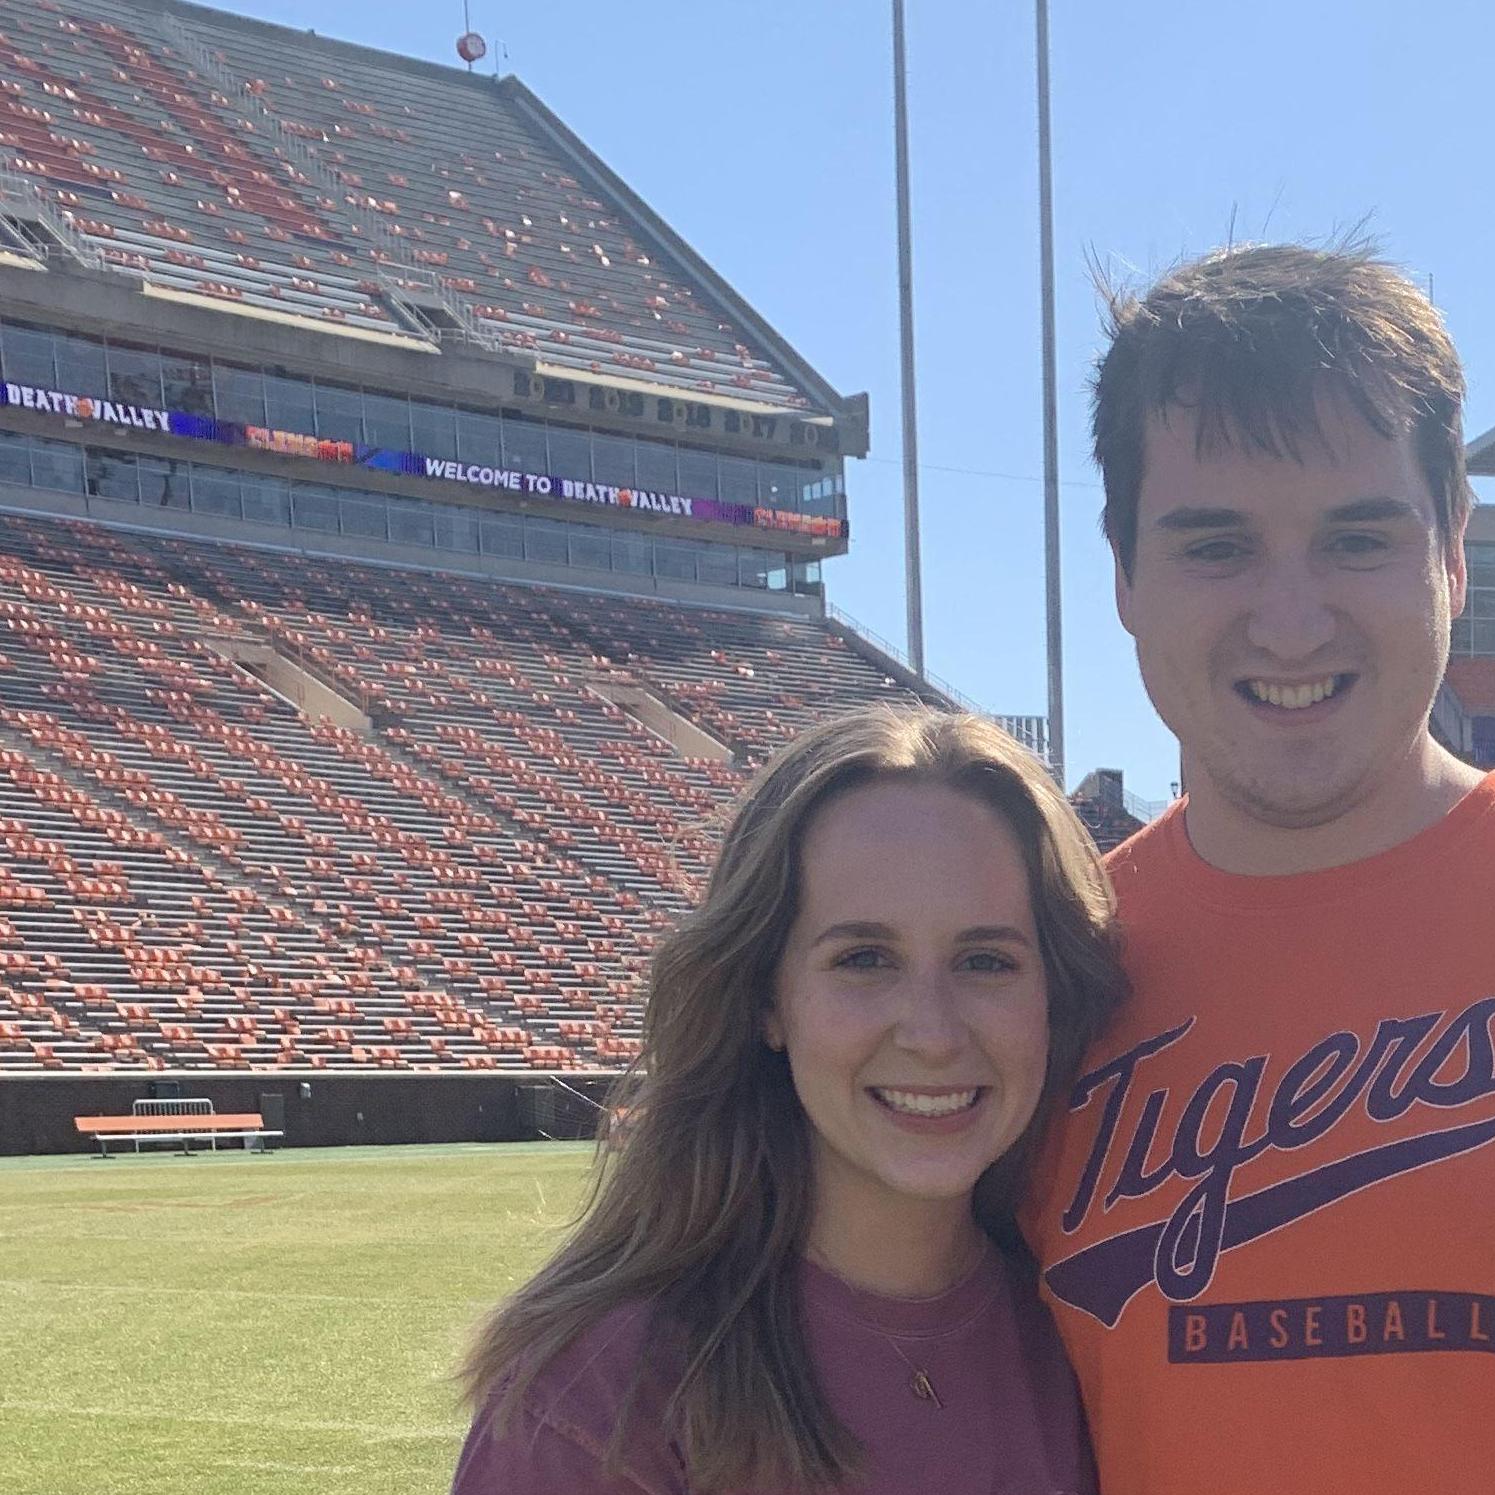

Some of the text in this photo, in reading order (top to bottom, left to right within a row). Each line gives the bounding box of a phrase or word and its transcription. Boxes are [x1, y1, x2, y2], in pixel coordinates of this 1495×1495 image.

[6, 383, 170, 432] DEATH VALLEY
[425, 457, 693, 516] WELCOME TO DEATH VALLEY
[1184, 1300, 1491, 1354] BASEBALL
